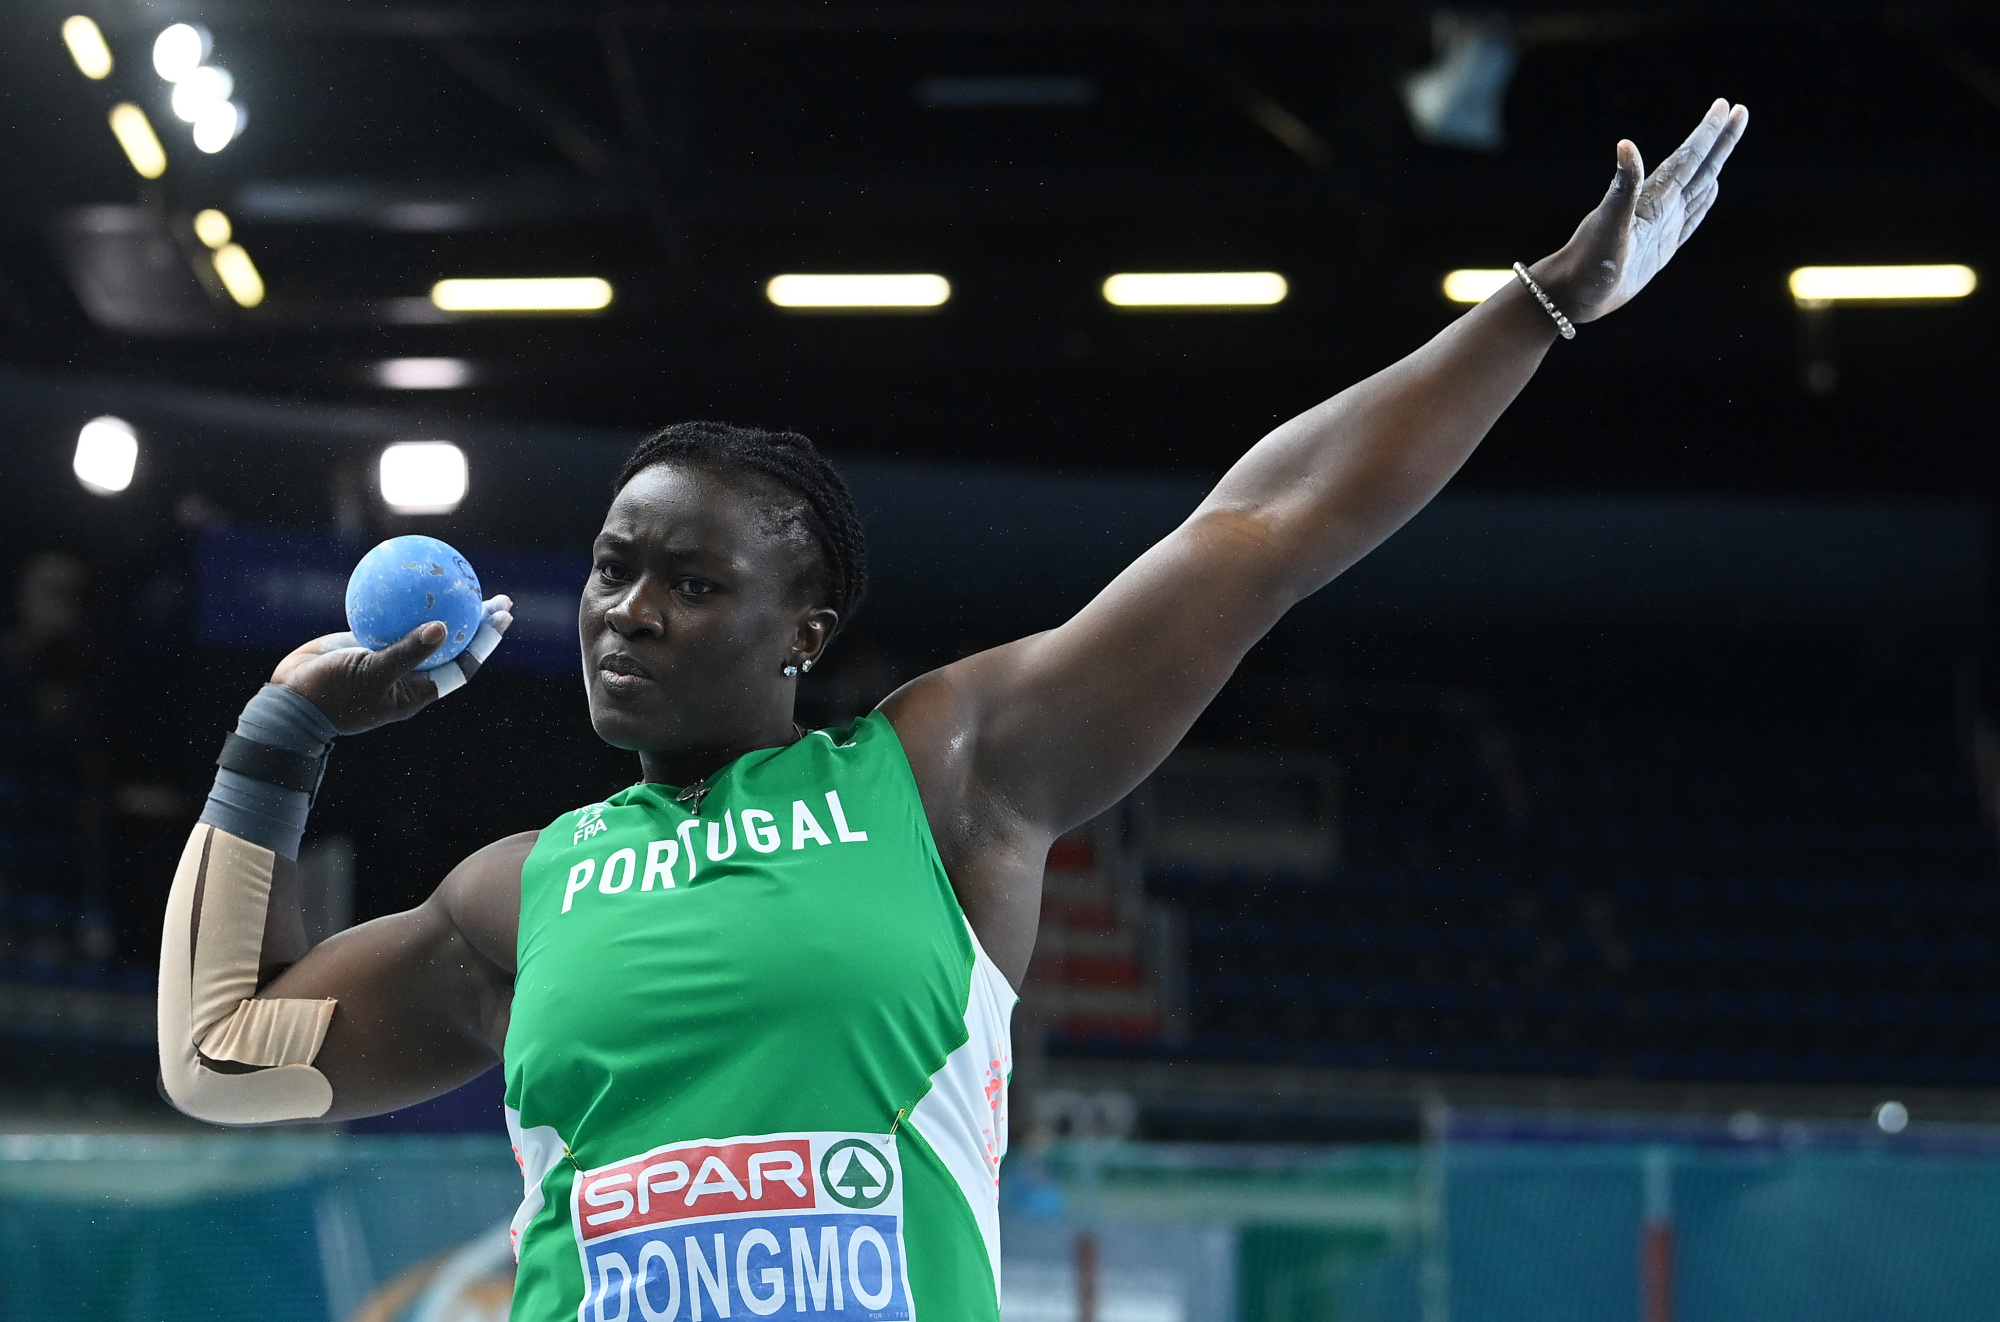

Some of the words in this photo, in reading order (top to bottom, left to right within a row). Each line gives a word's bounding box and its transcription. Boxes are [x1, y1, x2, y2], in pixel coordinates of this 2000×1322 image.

[561, 789, 868, 914] PORTUGAL
[573, 818, 608, 846] FPA
[583, 1150, 808, 1226] SPAR
[594, 1225, 893, 1322] DONGMO
